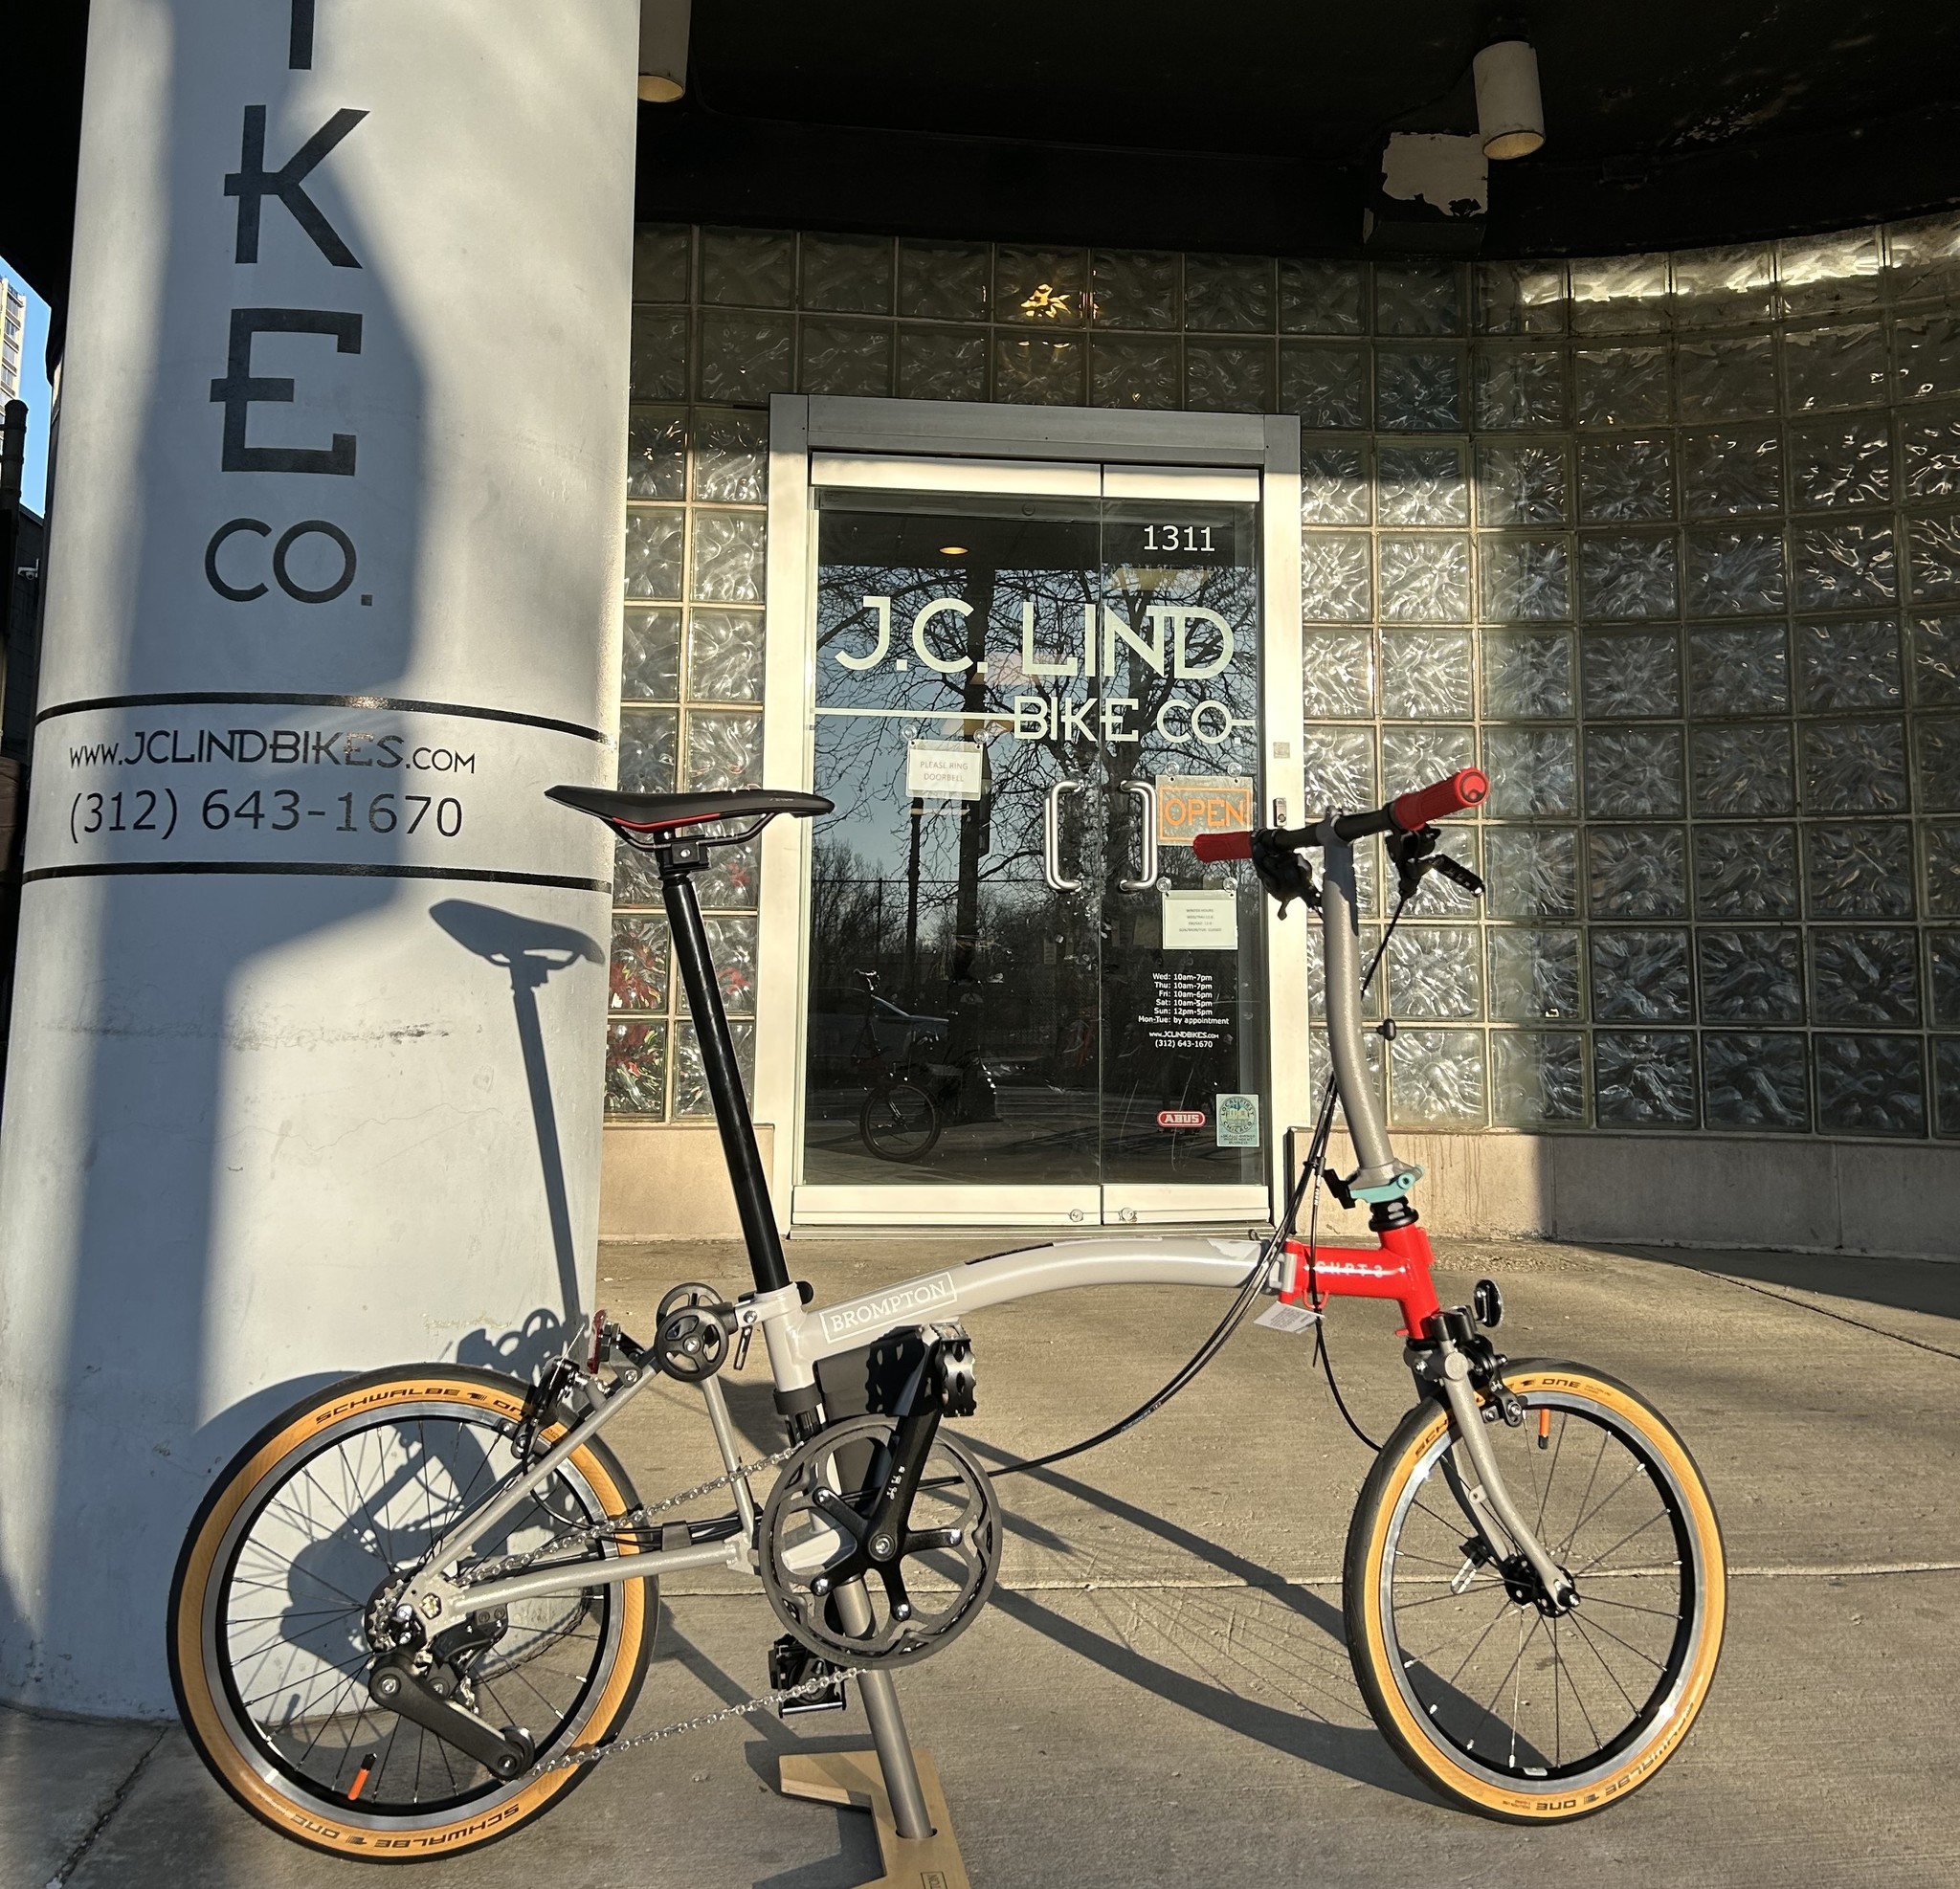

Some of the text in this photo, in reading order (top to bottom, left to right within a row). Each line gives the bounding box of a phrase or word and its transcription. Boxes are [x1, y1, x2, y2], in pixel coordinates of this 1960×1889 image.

[1143, 524, 1216, 553] 1311
[205, 518, 373, 607] CO.
[834, 595, 1236, 679] J.C. LIND
[1013, 696, 1242, 744] BIKE CO.
[920, 761, 947, 769] PLEASE
[924, 773, 965, 782] DOORBELL
[70, 788, 462, 844] (312) 643-1670
[1164, 798, 1245, 827] OPEN
[1173, 973, 1213, 982] 10am-7pm
[1173, 982, 1213, 990] 10am-7pm
[1173, 990, 1213, 999] 10am-6pm
[1173, 1008, 1213, 1016] 12pm-5pm
[1172, 1016, 1183, 1025] by
[1155, 1039, 1214, 1048] (312) 643-1670
[1220, 1099, 1255, 1116] LOCAL FIRST
[1164, 1114, 1199, 1123] ABUS
[1223, 1121, 1253, 1133] CHICAGO
[829, 1280, 947, 1332] BROMPTON
[1542, 1378, 1581, 1389] ONE
[316, 1388, 460, 1425] SCHWALBE
[1535, 1799, 1576, 1811] ONE
[290, 1804, 520, 1849] SCHWALBE ONE
